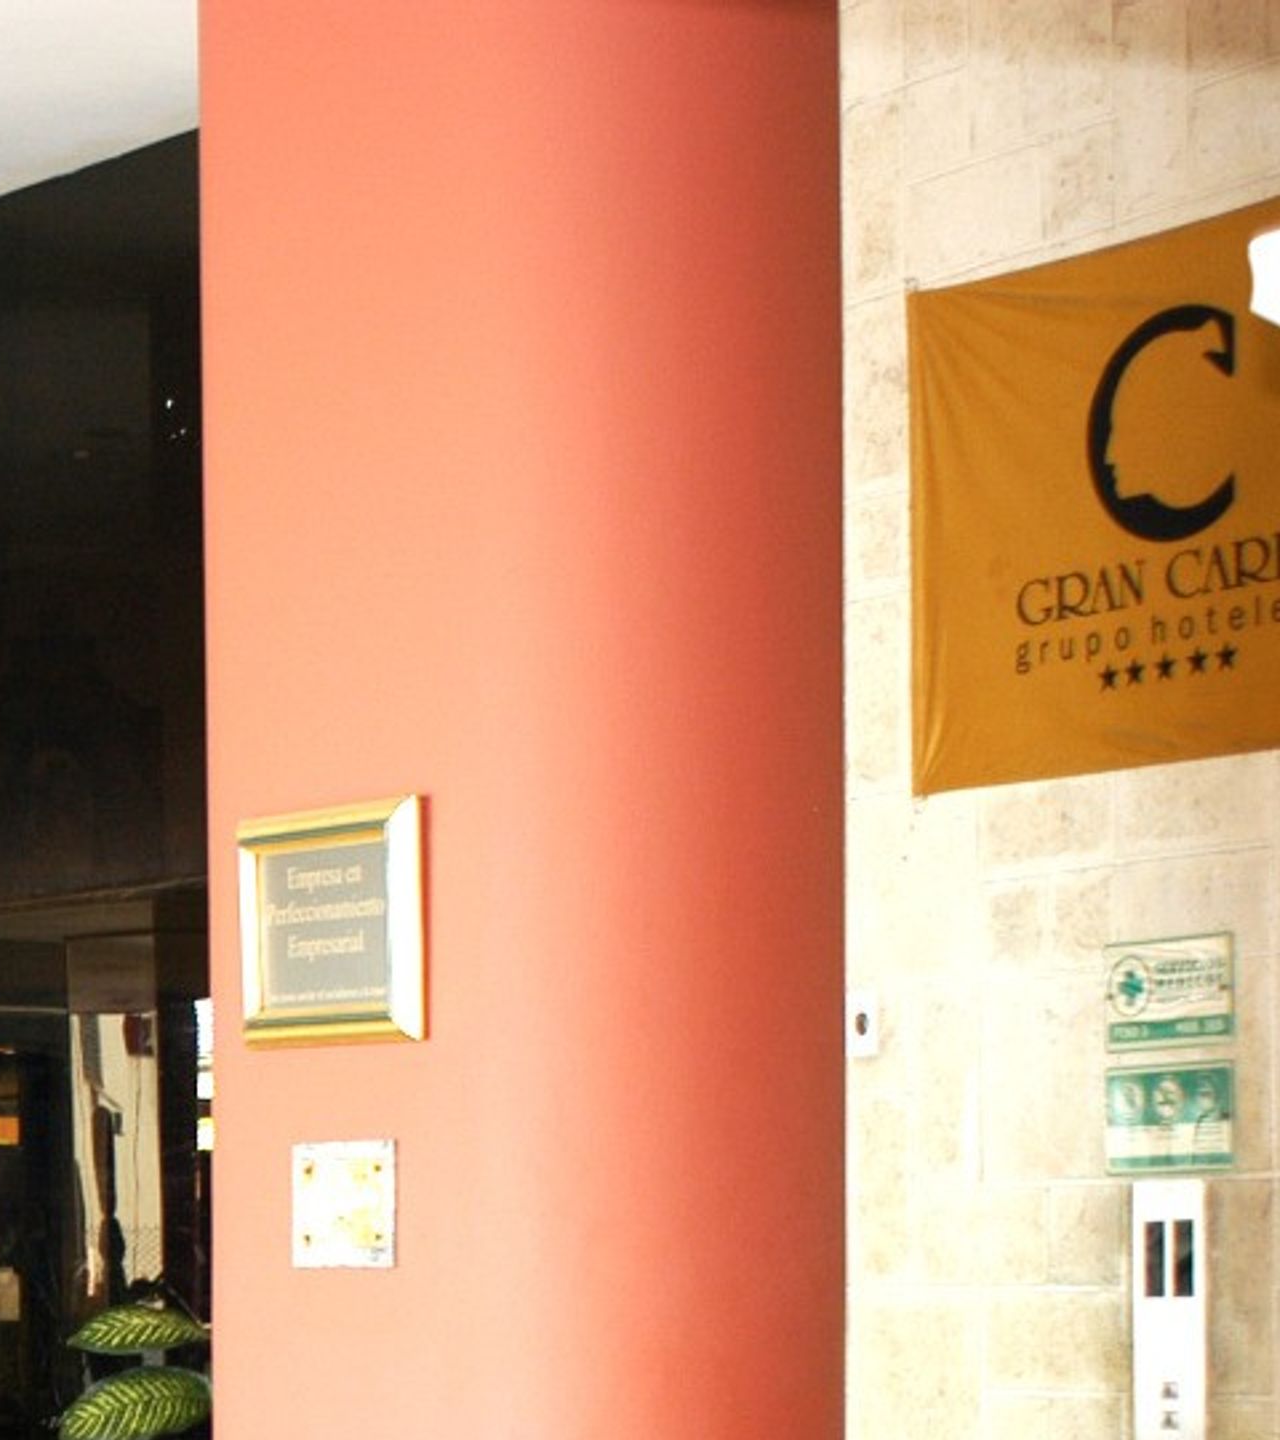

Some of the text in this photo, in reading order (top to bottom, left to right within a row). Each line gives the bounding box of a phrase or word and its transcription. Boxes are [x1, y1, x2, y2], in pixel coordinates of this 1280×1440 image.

[1016, 559, 1145, 627] GRAN
[1016, 626, 1131, 675] grupo
[287, 866, 342, 894] Empresa
